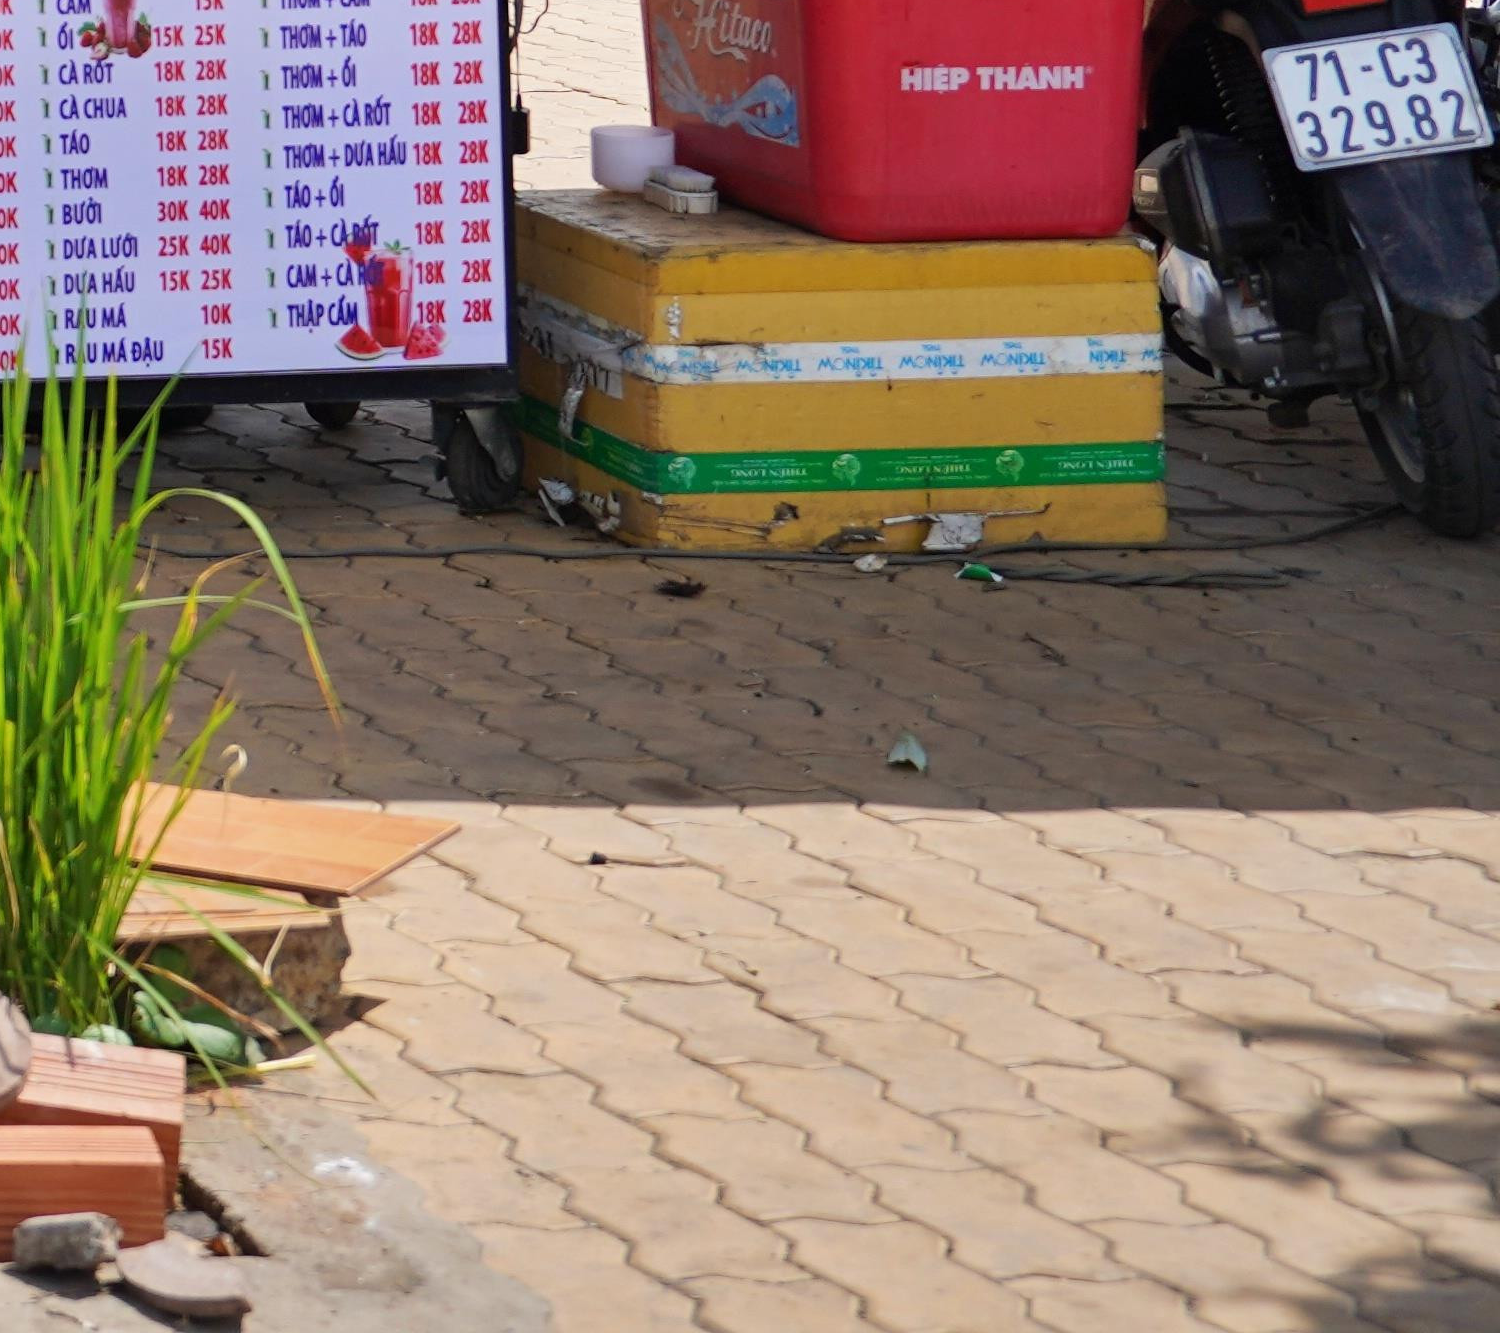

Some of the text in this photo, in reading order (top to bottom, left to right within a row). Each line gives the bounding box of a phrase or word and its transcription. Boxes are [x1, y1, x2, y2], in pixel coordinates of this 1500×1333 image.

[280, 19, 482, 49] THƠM TÁO 18K 28K
[900, 63, 970, 94] HIỆP
[1296, 38, 1437, 101] 71-C3
[59, 94, 228, 119] CÀ CHUA 18K 28K
[282, 94, 487, 128] THƠM CÀ RỐT 18K 28K
[1297, 89, 1476, 158] 329.82
[60, 129, 228, 154] TÁO 18K 28K
[60, 164, 230, 190] THƠM 18K 28K
[62, 197, 230, 225] BƯỞI 30K 40K
[63, 232, 231, 260] DƯA LƯỚI 25K 40K
